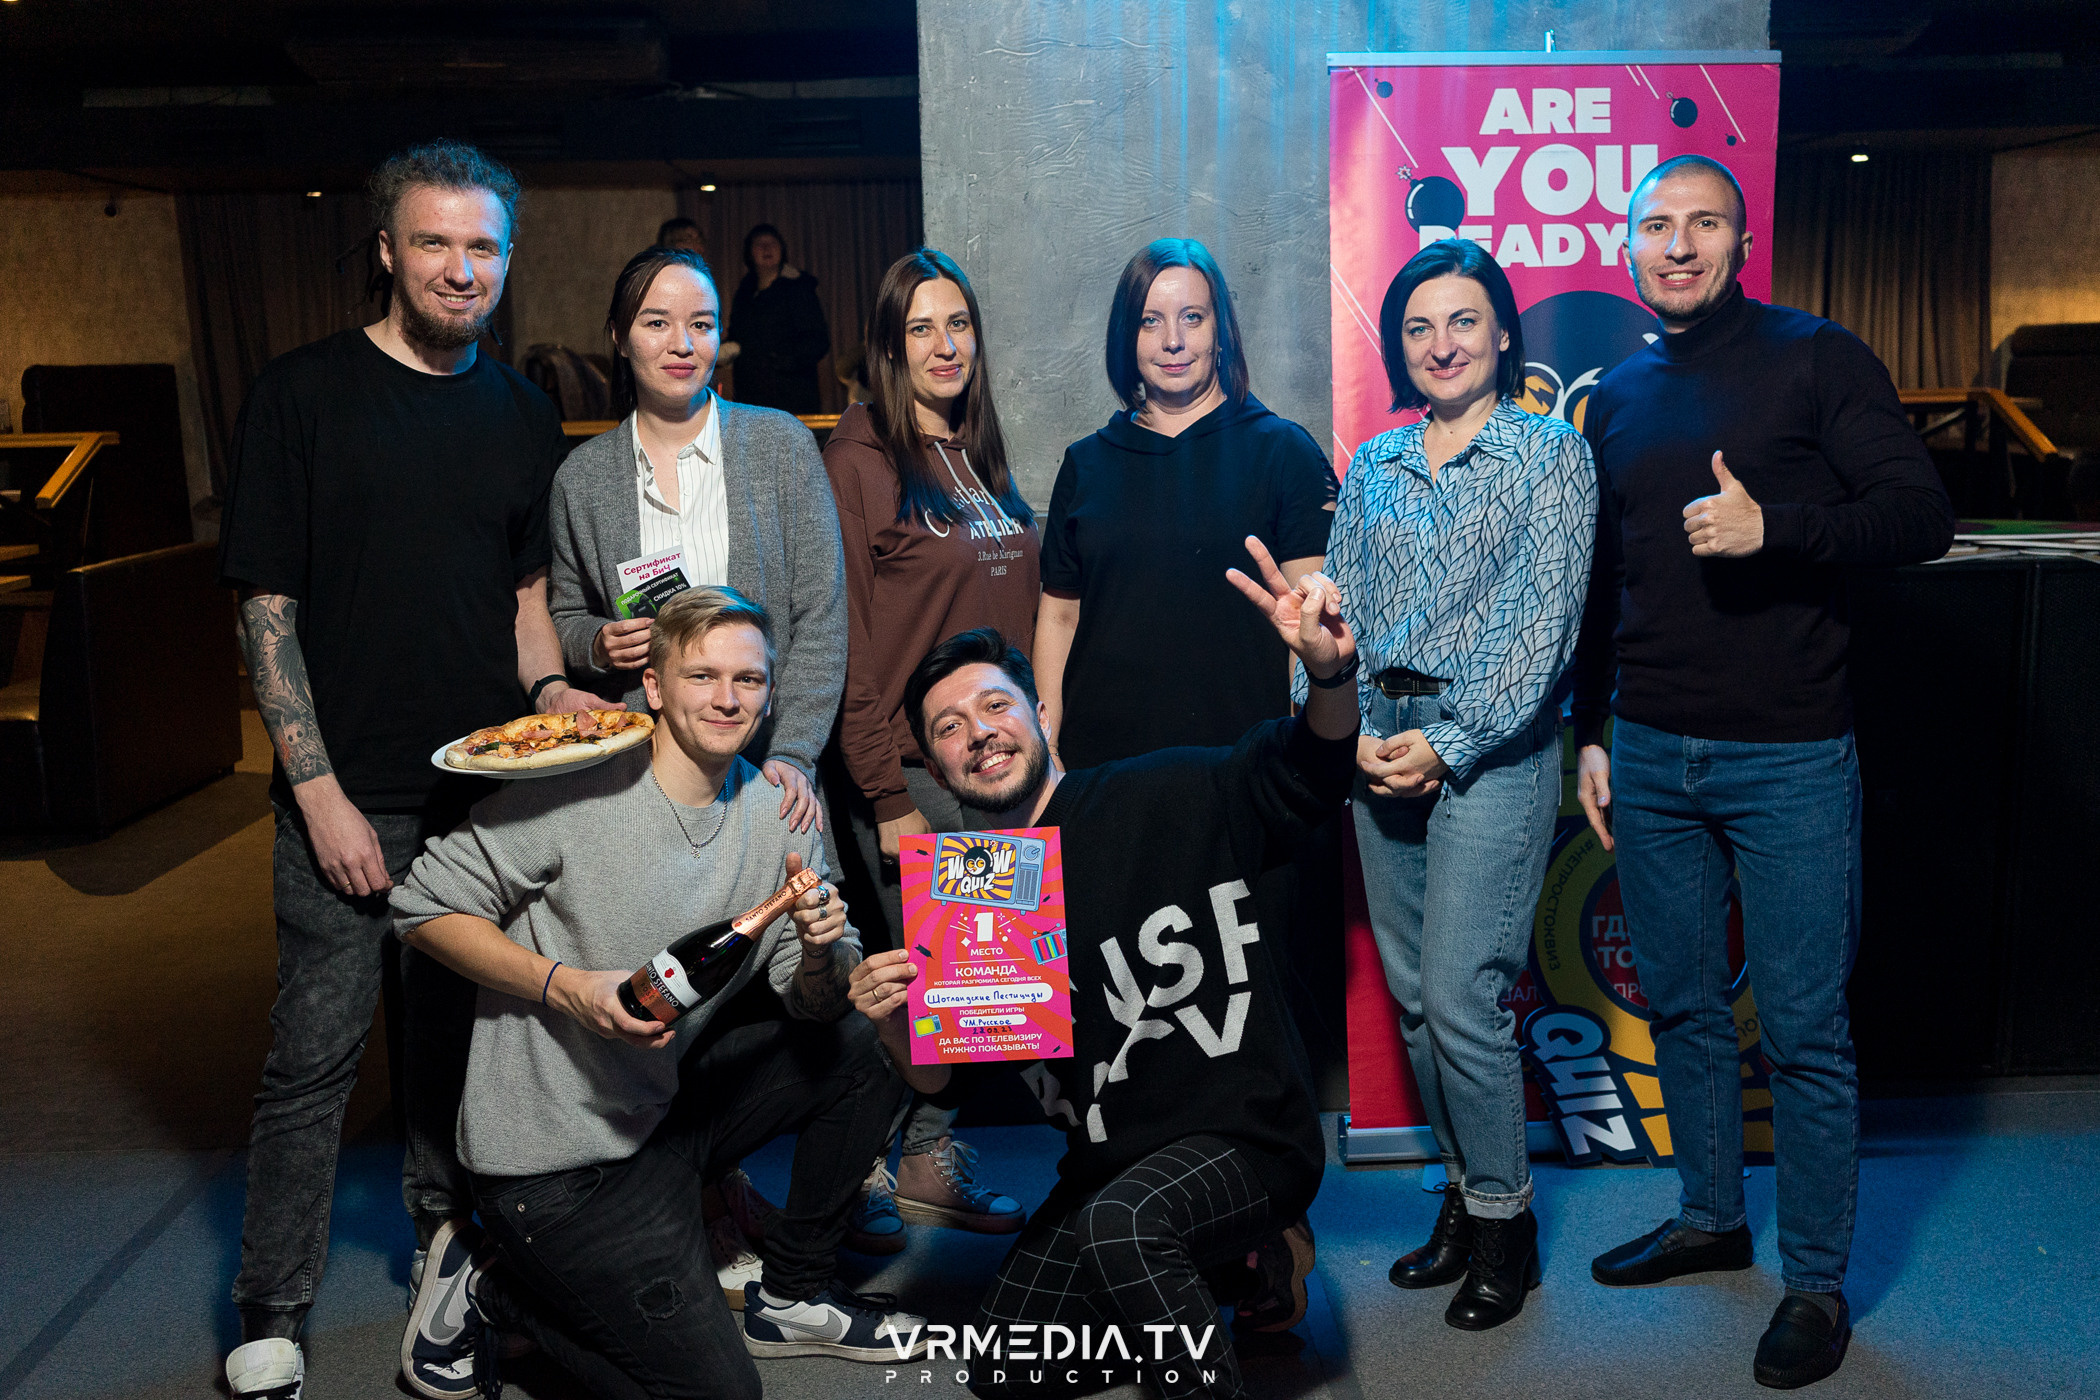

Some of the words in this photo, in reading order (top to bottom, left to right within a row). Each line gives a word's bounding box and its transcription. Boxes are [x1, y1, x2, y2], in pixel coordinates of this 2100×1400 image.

[1479, 87, 1611, 135] ARE
[1441, 143, 1658, 216] YOU
[624, 553, 681, 576] Сертификат
[990, 565, 1007, 576] PARIS
[639, 572, 650, 581] на
[651, 572, 679, 589] СЕРТИФИКАТ
[653, 588, 676, 602] СКИДКА
[675, 583, 687, 591] 10%
[960, 872, 996, 894] QUIZ
[745, 908, 764, 922] SANTO
[763, 891, 787, 910] STEFANO
[973, 912, 994, 942] 1
[1591, 915, 1630, 942] ГД
[970, 947, 1004, 957] МЕСТО
[955, 965, 1018, 977] КОМАНДА
[653, 978, 679, 1007] STEFANO
[927, 993, 991, 1005] Шотландские
[993, 990, 1043, 1003] Пестициды
[959, 1008, 1005, 1016] ПОБЕДИТЕЛИ
[1006, 1006, 1025, 1014] ИГРЫ
[938, 1037, 952, 1046] ДА
[953, 1036, 970, 1045] ВАС
[971, 1035, 985, 1043] ПО
[986, 1033, 1043, 1042] ТЕЛЕВИЗИРУ
[943, 1045, 977, 1054] НУЖНО
[978, 1042, 1040, 1053] ПОКАЗЫВАТЬ!
[1530, 1012, 1637, 1156] QUIZ
